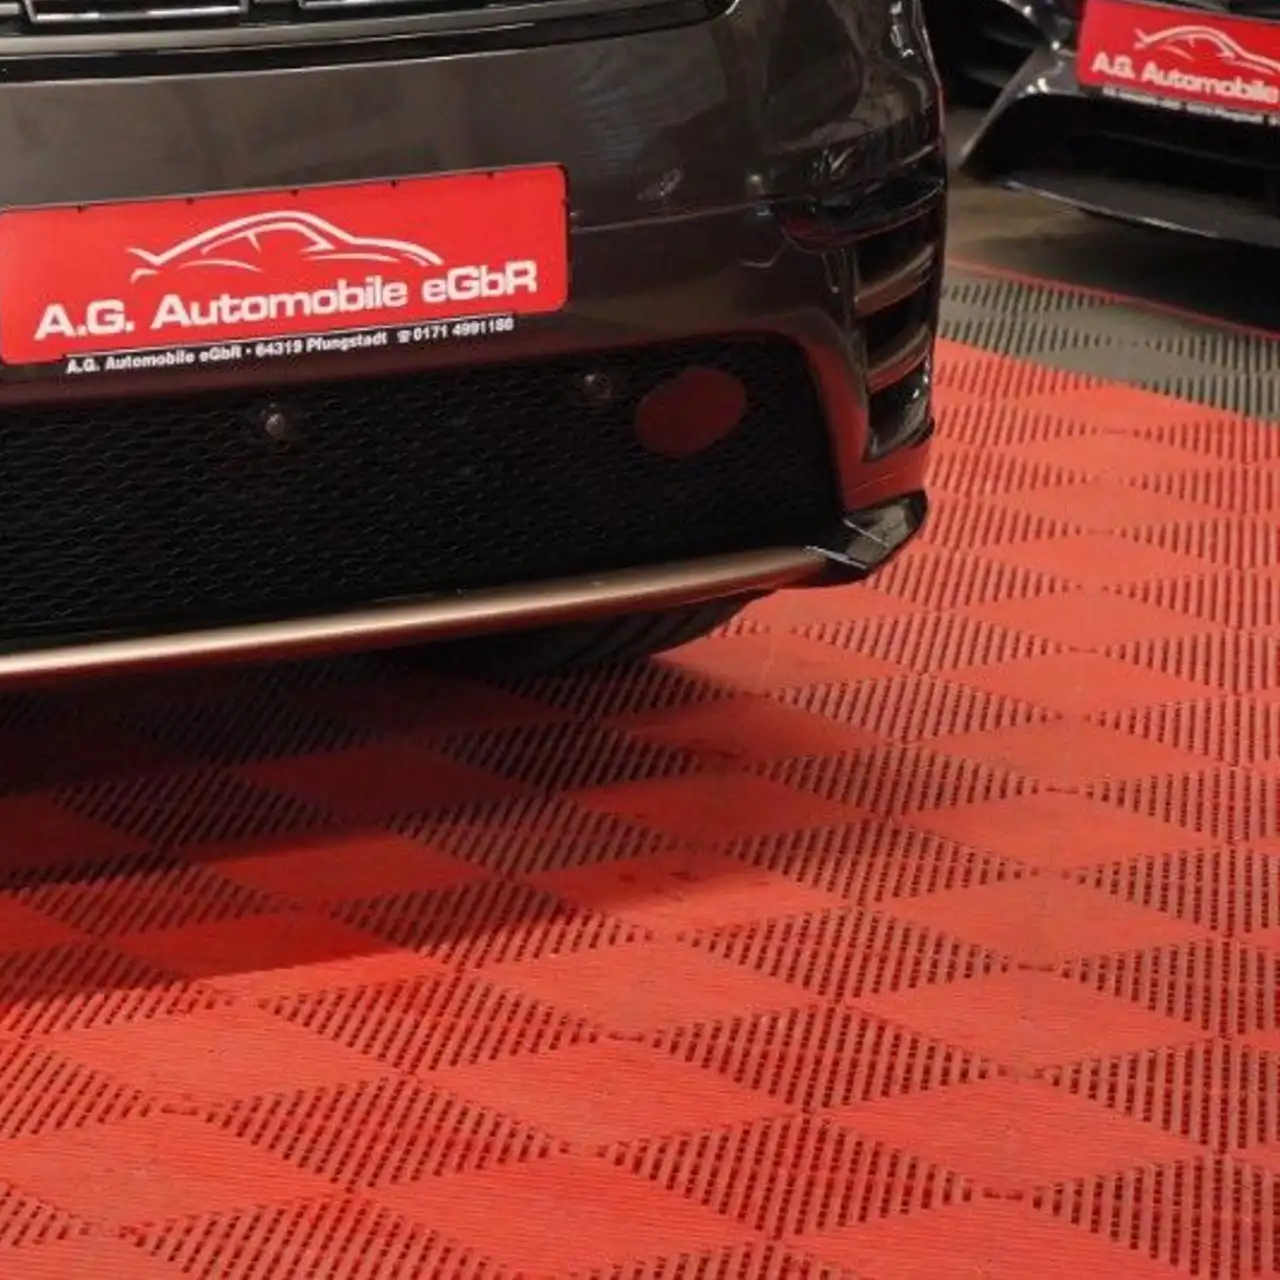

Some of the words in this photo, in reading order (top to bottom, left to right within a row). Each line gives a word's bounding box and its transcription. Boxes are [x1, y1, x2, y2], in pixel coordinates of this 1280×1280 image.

[1141, 60, 1280, 104] Automobile
[34, 298, 135, 341] A.G.
[151, 275, 408, 329] Automobile
[421, 260, 537, 303] eGbR
[66, 358, 100, 375] A.G.
[105, 349, 194, 371] Automobile
[306, 331, 388, 352] Pfungstadt
